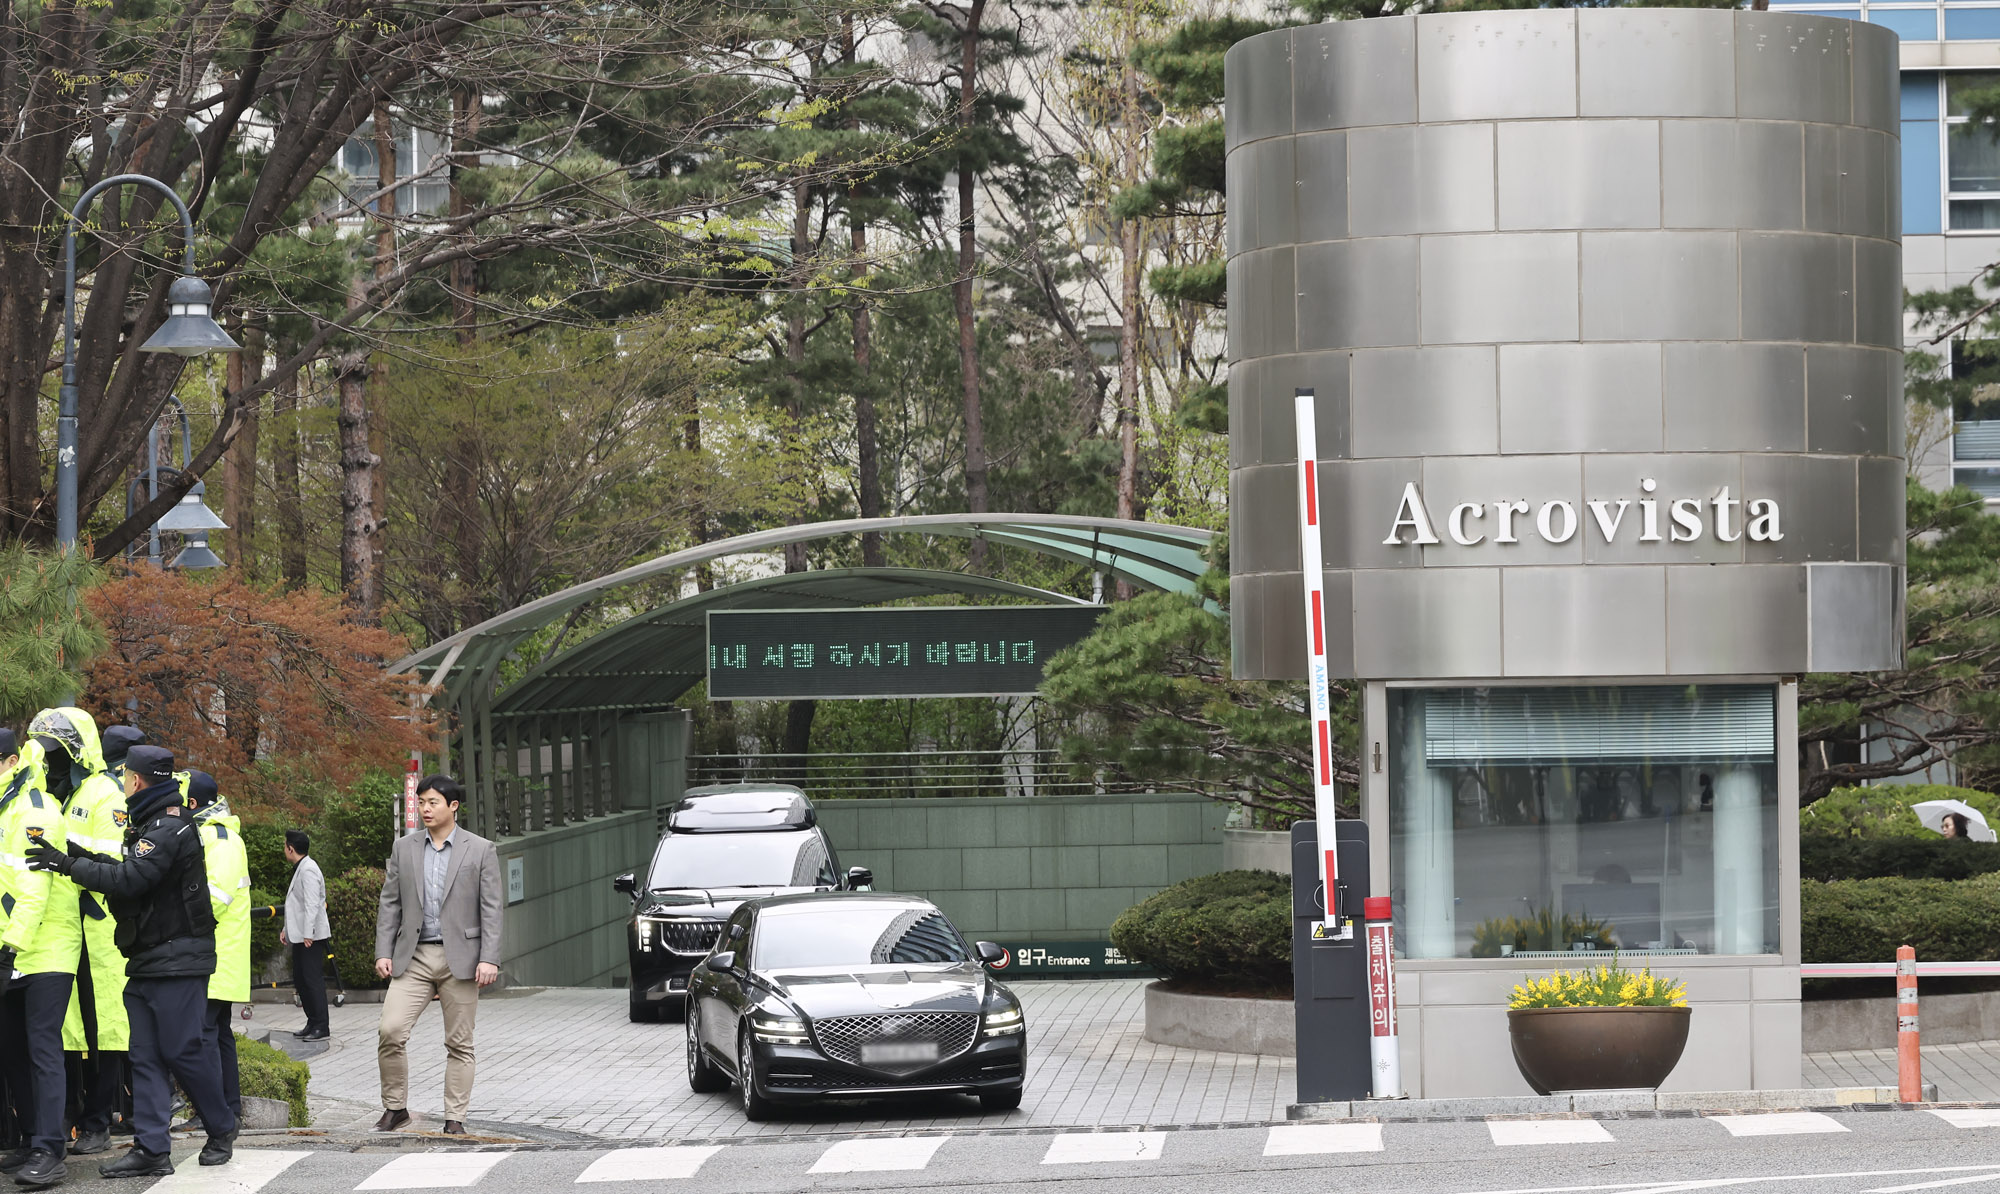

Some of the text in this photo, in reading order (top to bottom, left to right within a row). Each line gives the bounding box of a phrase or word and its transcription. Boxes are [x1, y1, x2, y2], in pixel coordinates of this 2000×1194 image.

[1382, 478, 1785, 545] Acrovista
[829, 642, 909, 667] 하시기
[926, 640, 1036, 666] 바랍니다
[1315, 664, 1326, 711] AMANO
[1017, 948, 1091, 966] 입구 Entrance
[1371, 935, 1388, 1028] 출차주의
